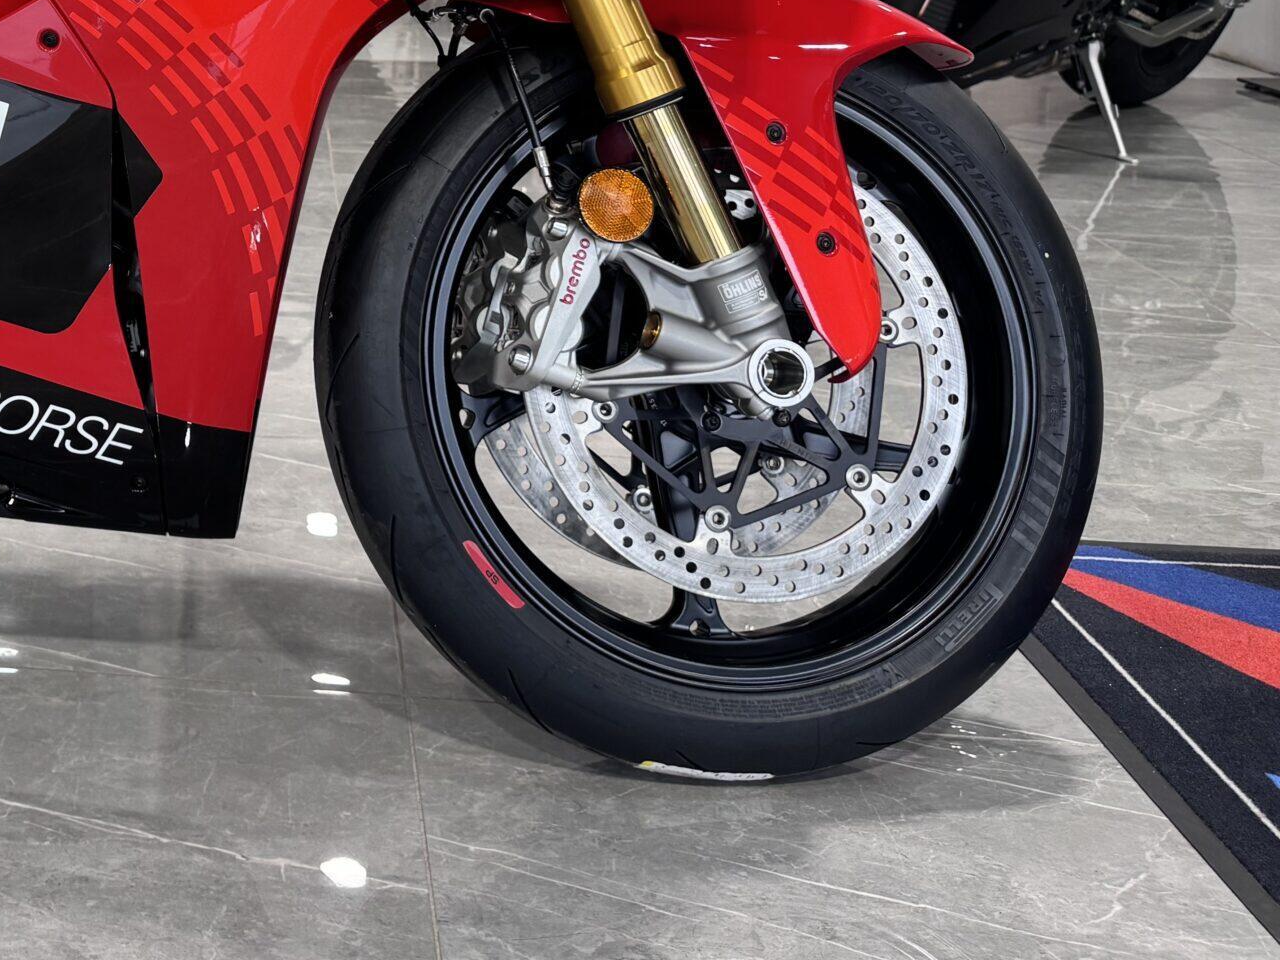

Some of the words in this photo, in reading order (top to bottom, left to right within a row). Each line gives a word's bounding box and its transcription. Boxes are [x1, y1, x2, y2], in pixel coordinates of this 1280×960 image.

[560, 237, 591, 305] brembo
[722, 275, 762, 299] ÖHLINS
[485, 569, 499, 585] SP
[935, 583, 1004, 652] PIRELLI
